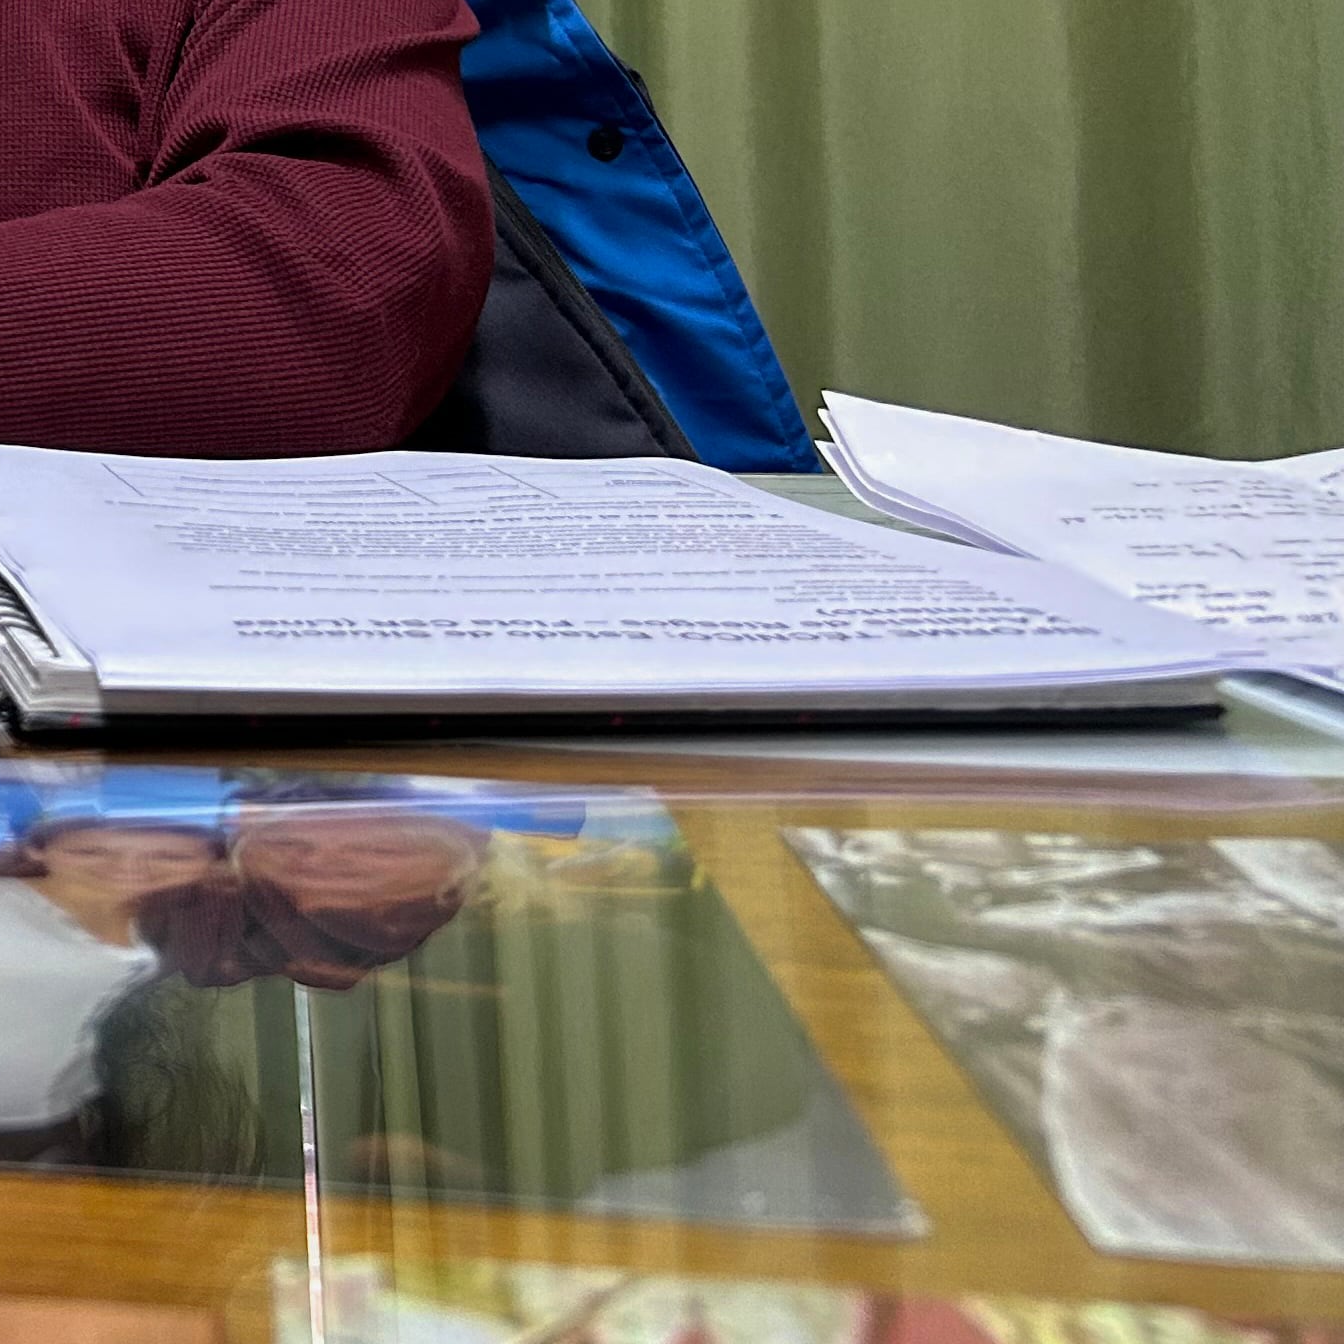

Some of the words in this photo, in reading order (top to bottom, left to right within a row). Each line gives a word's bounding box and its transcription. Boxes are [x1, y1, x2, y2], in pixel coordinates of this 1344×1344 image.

[799, 620, 852, 628] de
[445, 630, 493, 638] de
[506, 630, 653, 640] Estado
